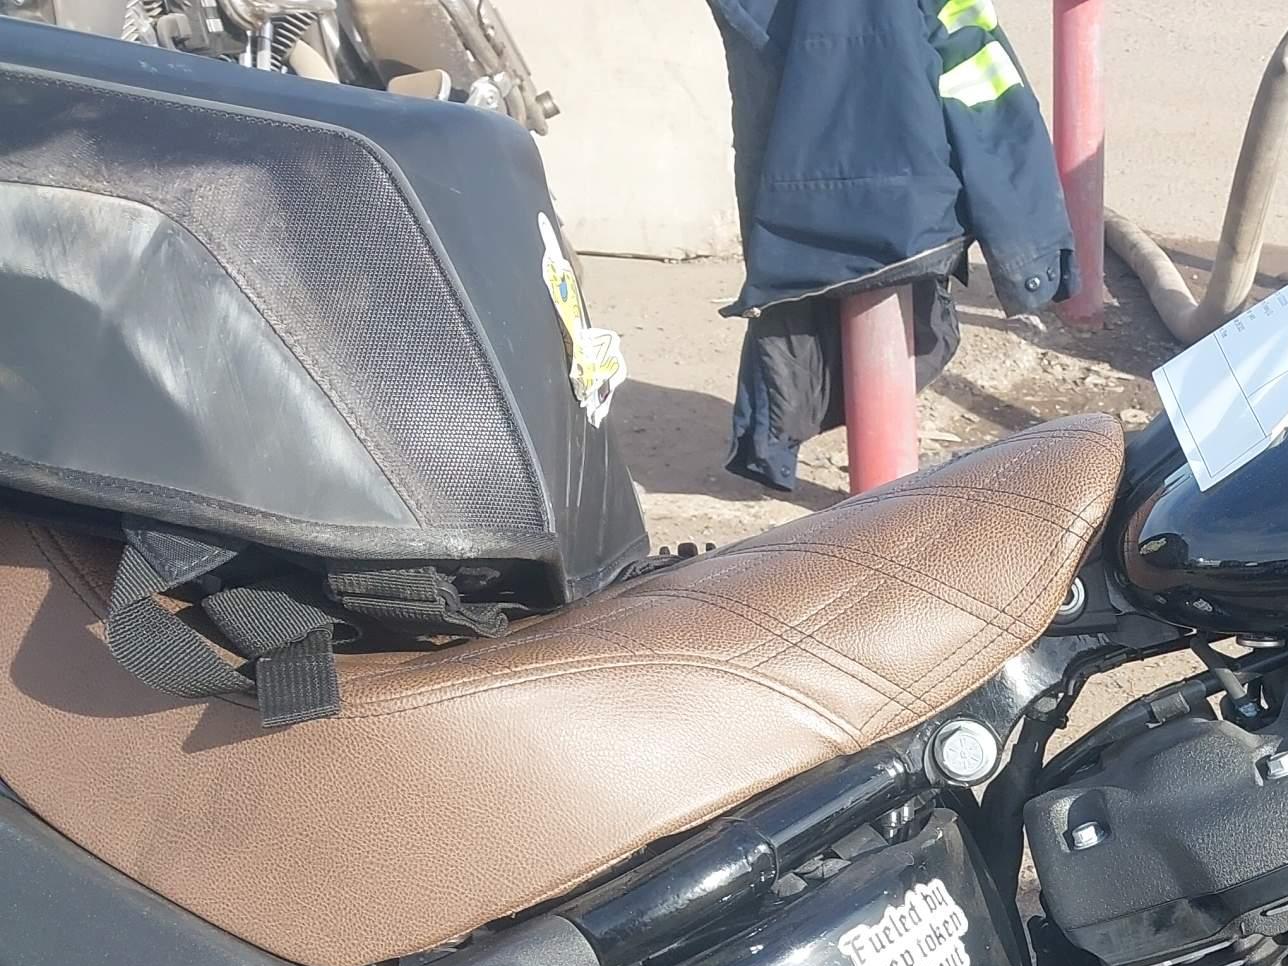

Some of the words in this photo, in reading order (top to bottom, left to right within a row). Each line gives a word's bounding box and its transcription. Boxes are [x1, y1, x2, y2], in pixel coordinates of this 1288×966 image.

[843, 903, 922, 964] Fueled
[923, 886, 947, 912] by
[916, 911, 962, 957] token
